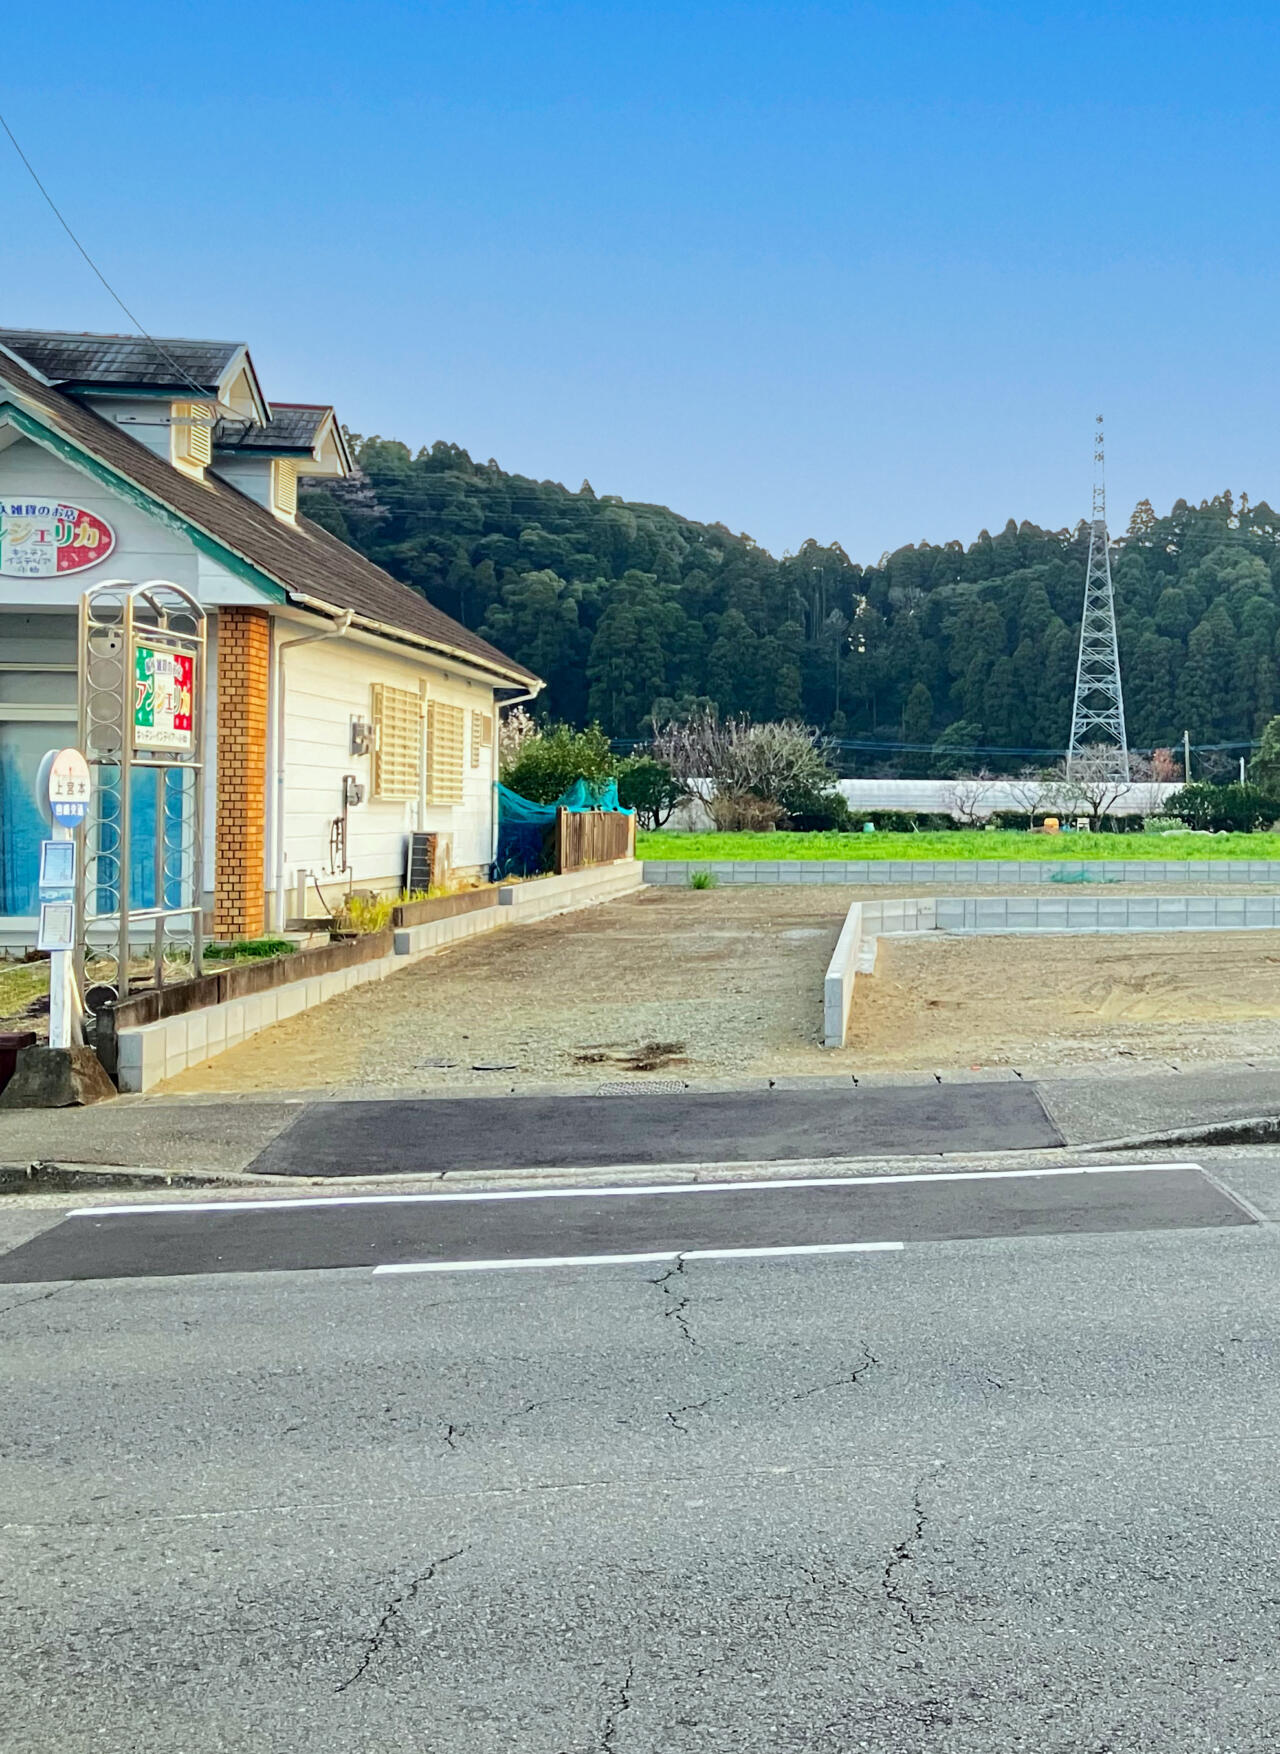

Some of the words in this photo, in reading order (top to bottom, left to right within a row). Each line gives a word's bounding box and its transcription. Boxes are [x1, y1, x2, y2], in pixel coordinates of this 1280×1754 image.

[136, 680, 190, 716] アンジェリカ
